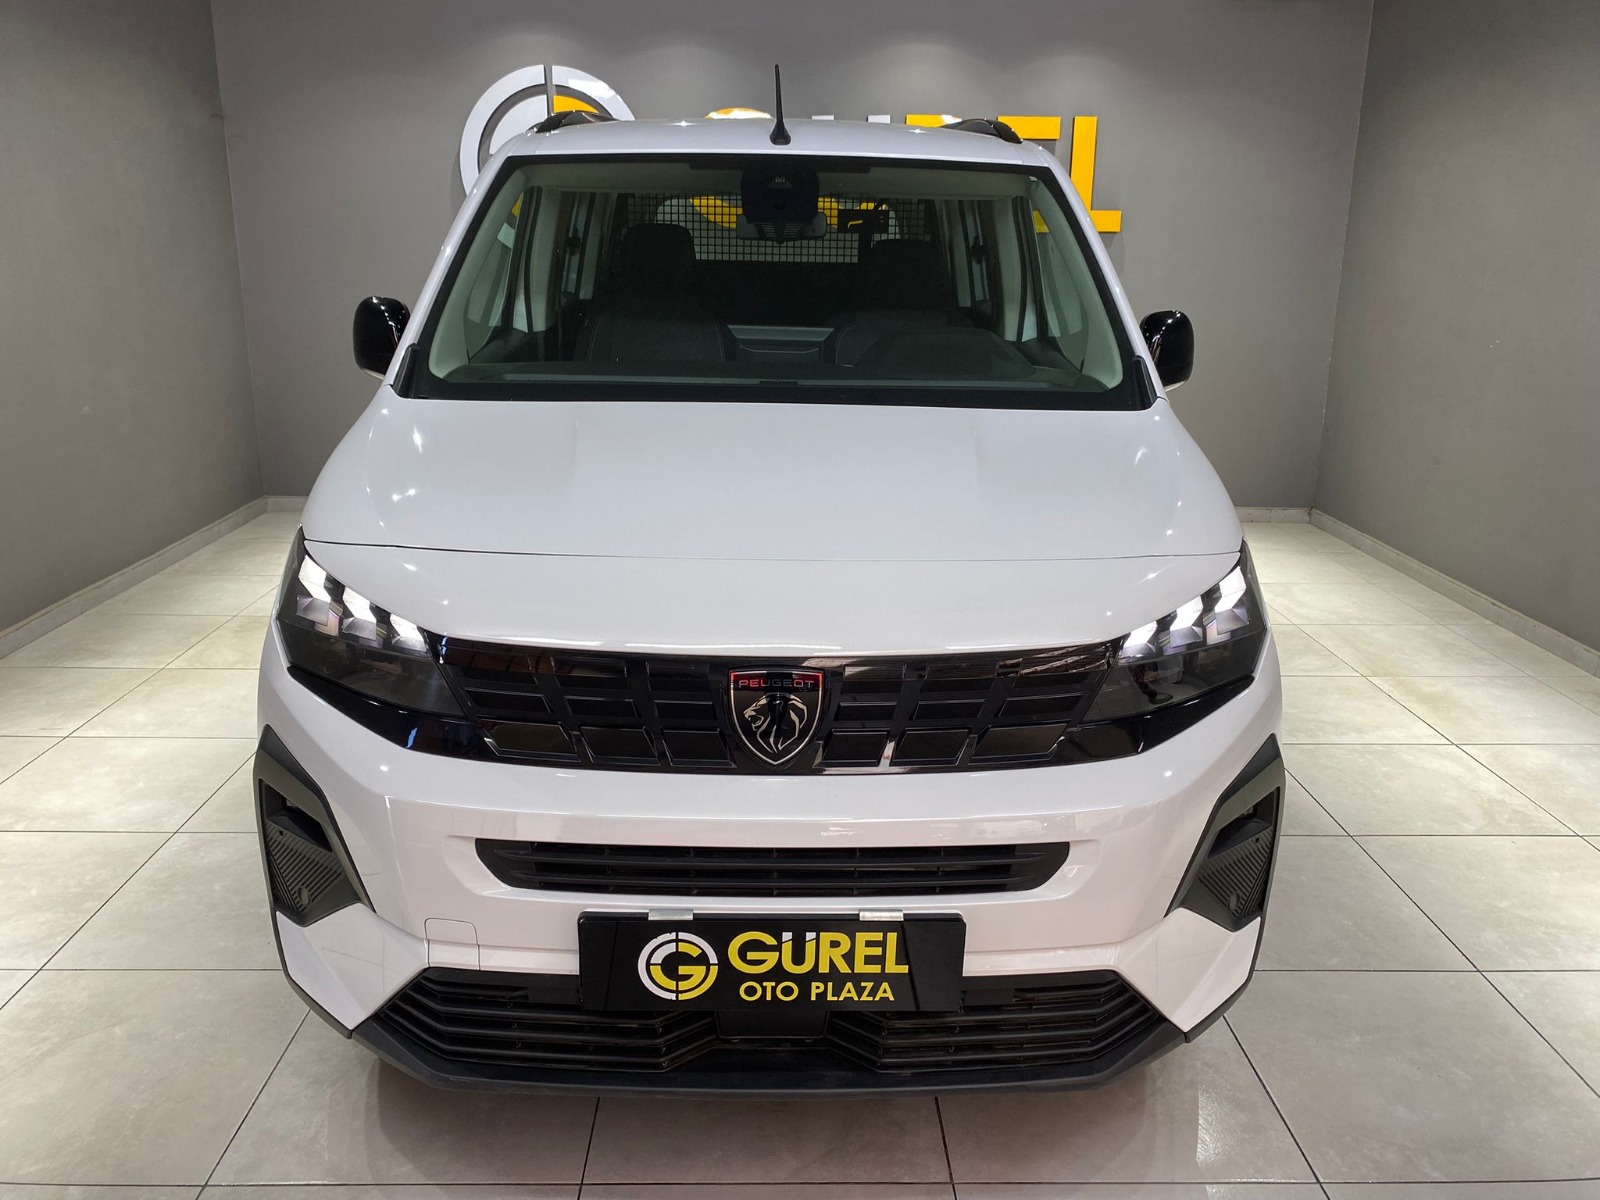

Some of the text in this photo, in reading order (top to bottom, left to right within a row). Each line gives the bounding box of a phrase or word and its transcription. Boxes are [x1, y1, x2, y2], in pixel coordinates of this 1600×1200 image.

[738, 679, 814, 688] PEUGEOT
[739, 981, 895, 1001] OTO PLAZA
